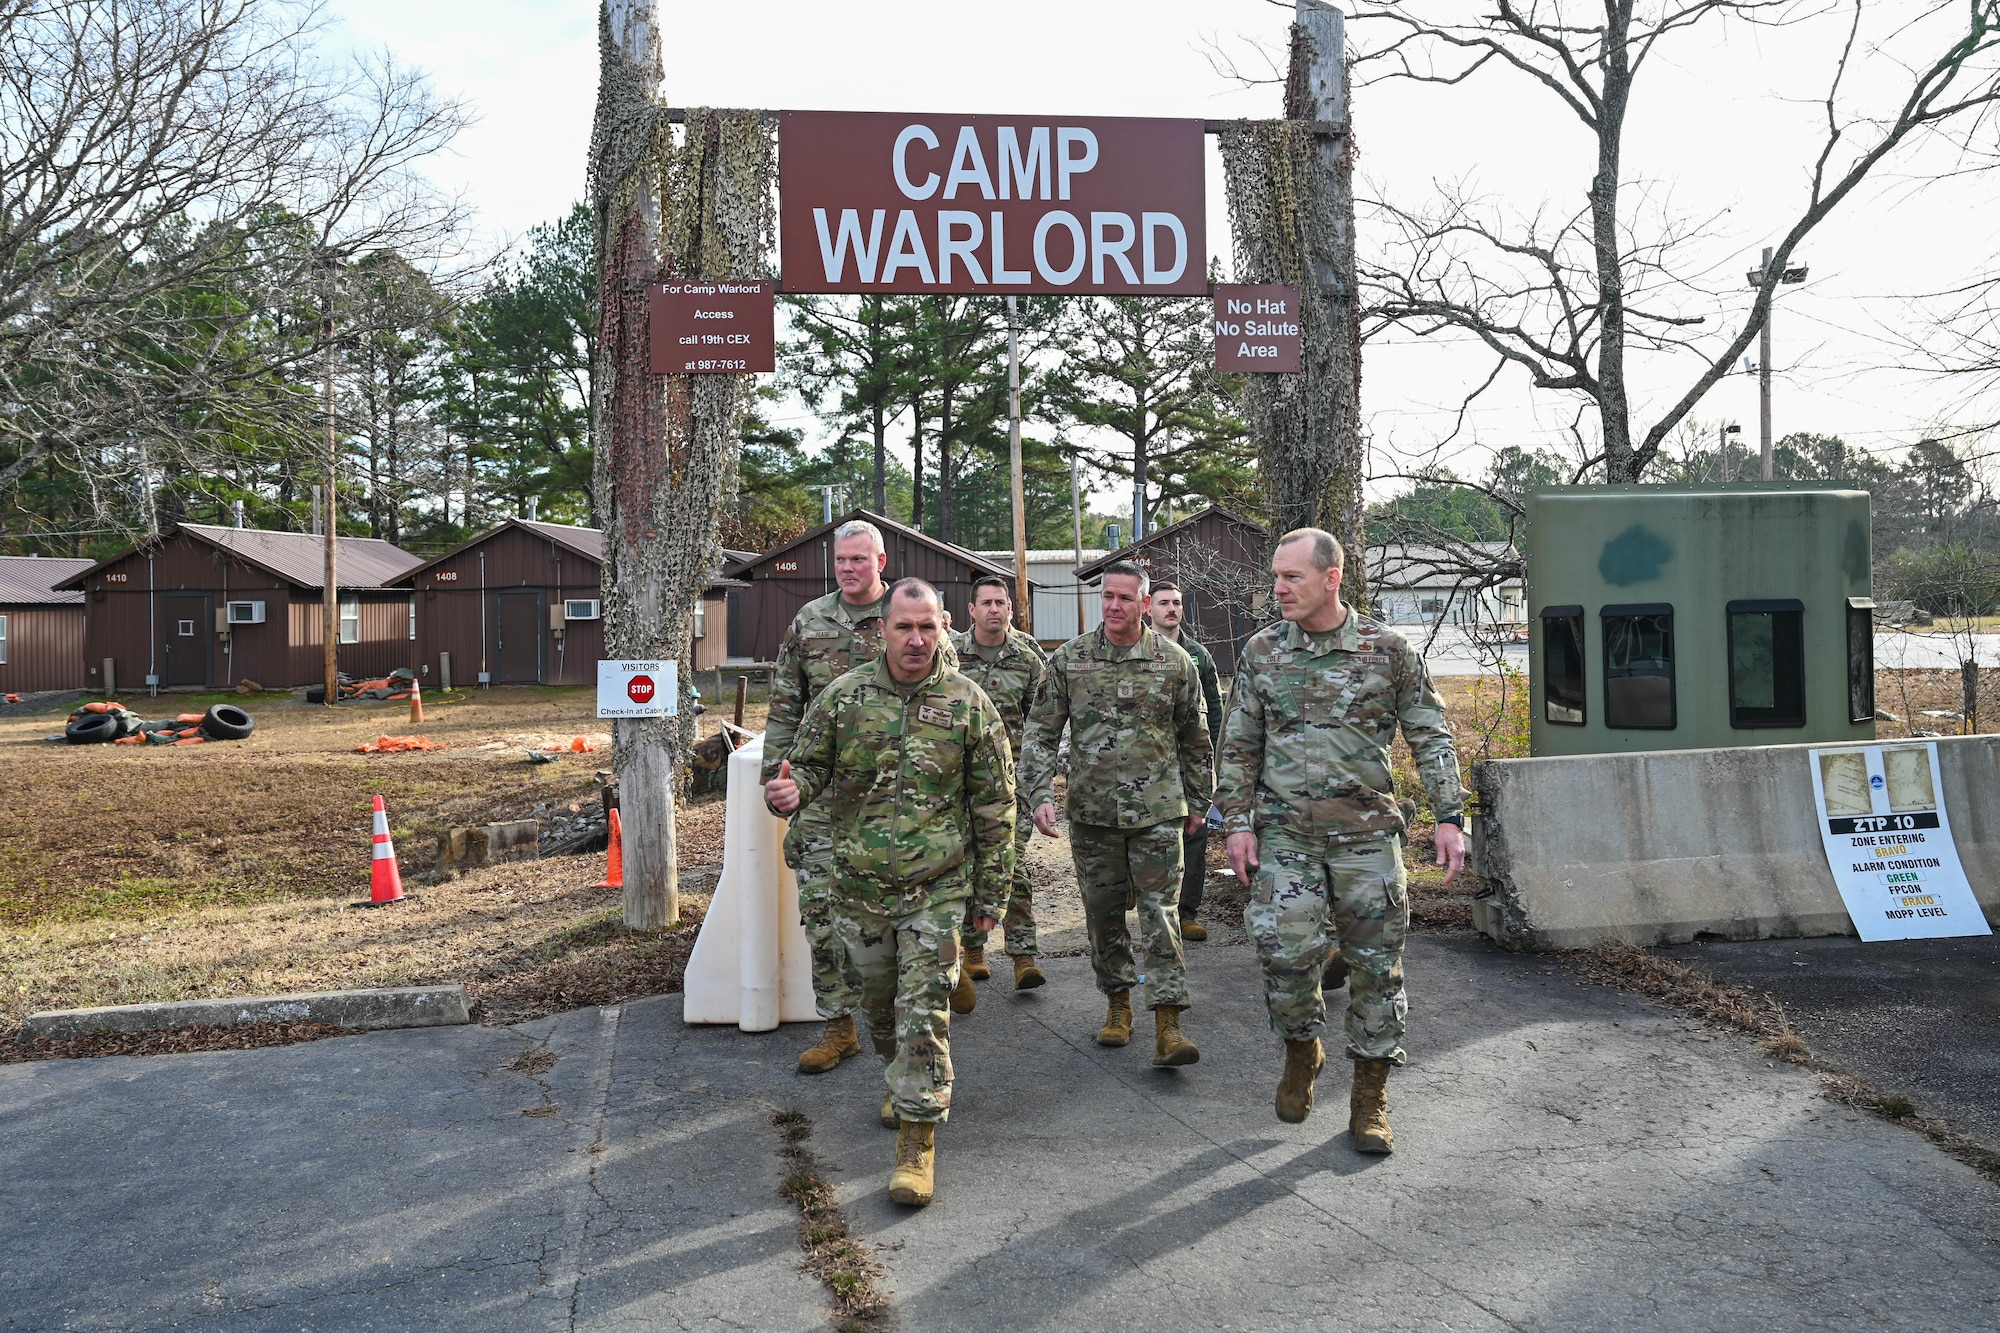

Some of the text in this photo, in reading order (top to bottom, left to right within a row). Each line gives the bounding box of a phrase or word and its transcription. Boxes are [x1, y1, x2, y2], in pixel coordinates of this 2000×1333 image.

[893, 124, 1099, 201] CAMP
[812, 207, 1188, 286] WARLORD
[662, 284, 761, 296] For Camp Warlord
[1227, 299, 1287, 315] No Hat
[693, 309, 734, 319] Access
[1215, 320, 1299, 336] No Salute
[679, 334, 751, 345] call 19th CEX
[1237, 342, 1278, 358] Area
[685, 360, 746, 370] at 987-7612
[775, 562, 798, 571] 1406
[106, 573, 127, 582] 1410
[435, 572, 457, 581] 1408
[621, 663, 660, 671] VISITORS
[631, 685, 652, 694] STOP
[1853, 815, 1915, 832] ZTP 10
[1851, 833, 1926, 847] ZONE ENTERING
[1875, 844, 1907, 858] BRAVO
[1852, 857, 1941, 873] ALARM CONDITION
[1886, 872, 1919, 883] GREEN
[1888, 884, 1922, 895] FPCON
[1901, 895, 1935, 907] BRAVO
[1885, 907, 1948, 920] MOPP LEVEL
